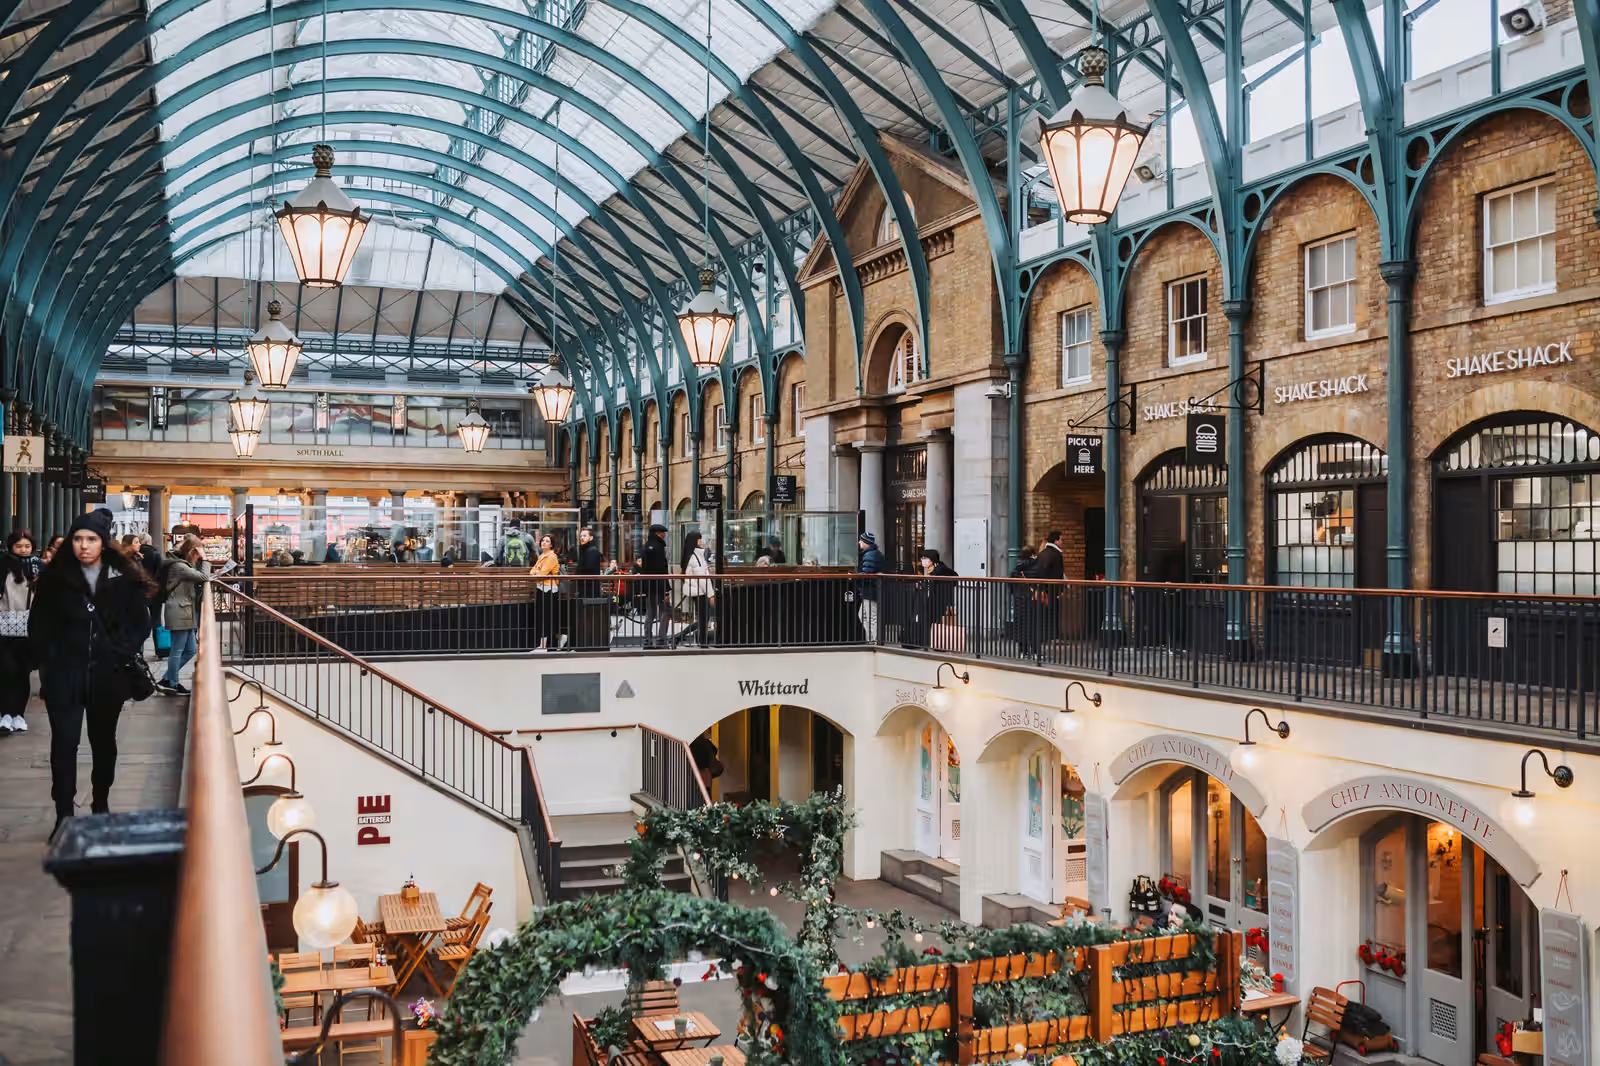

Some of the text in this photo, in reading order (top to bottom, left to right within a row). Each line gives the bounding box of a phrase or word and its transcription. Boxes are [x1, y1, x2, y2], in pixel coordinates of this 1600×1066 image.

[1446, 341, 1573, 378] SHAKE SHACK
[1274, 374, 1368, 404] SHAKE SHACK
[1143, 401, 1178, 421] SHAKE
[1067, 437, 1101, 447] PICK UP
[323, 449, 344, 457] HALL
[1074, 465, 1095, 474] HERE
[738, 678, 809, 697] Whittard
[1000, 709, 1057, 740] Sass & Belle
[1330, 783, 1497, 843] CHEZ ANTOINETTE
